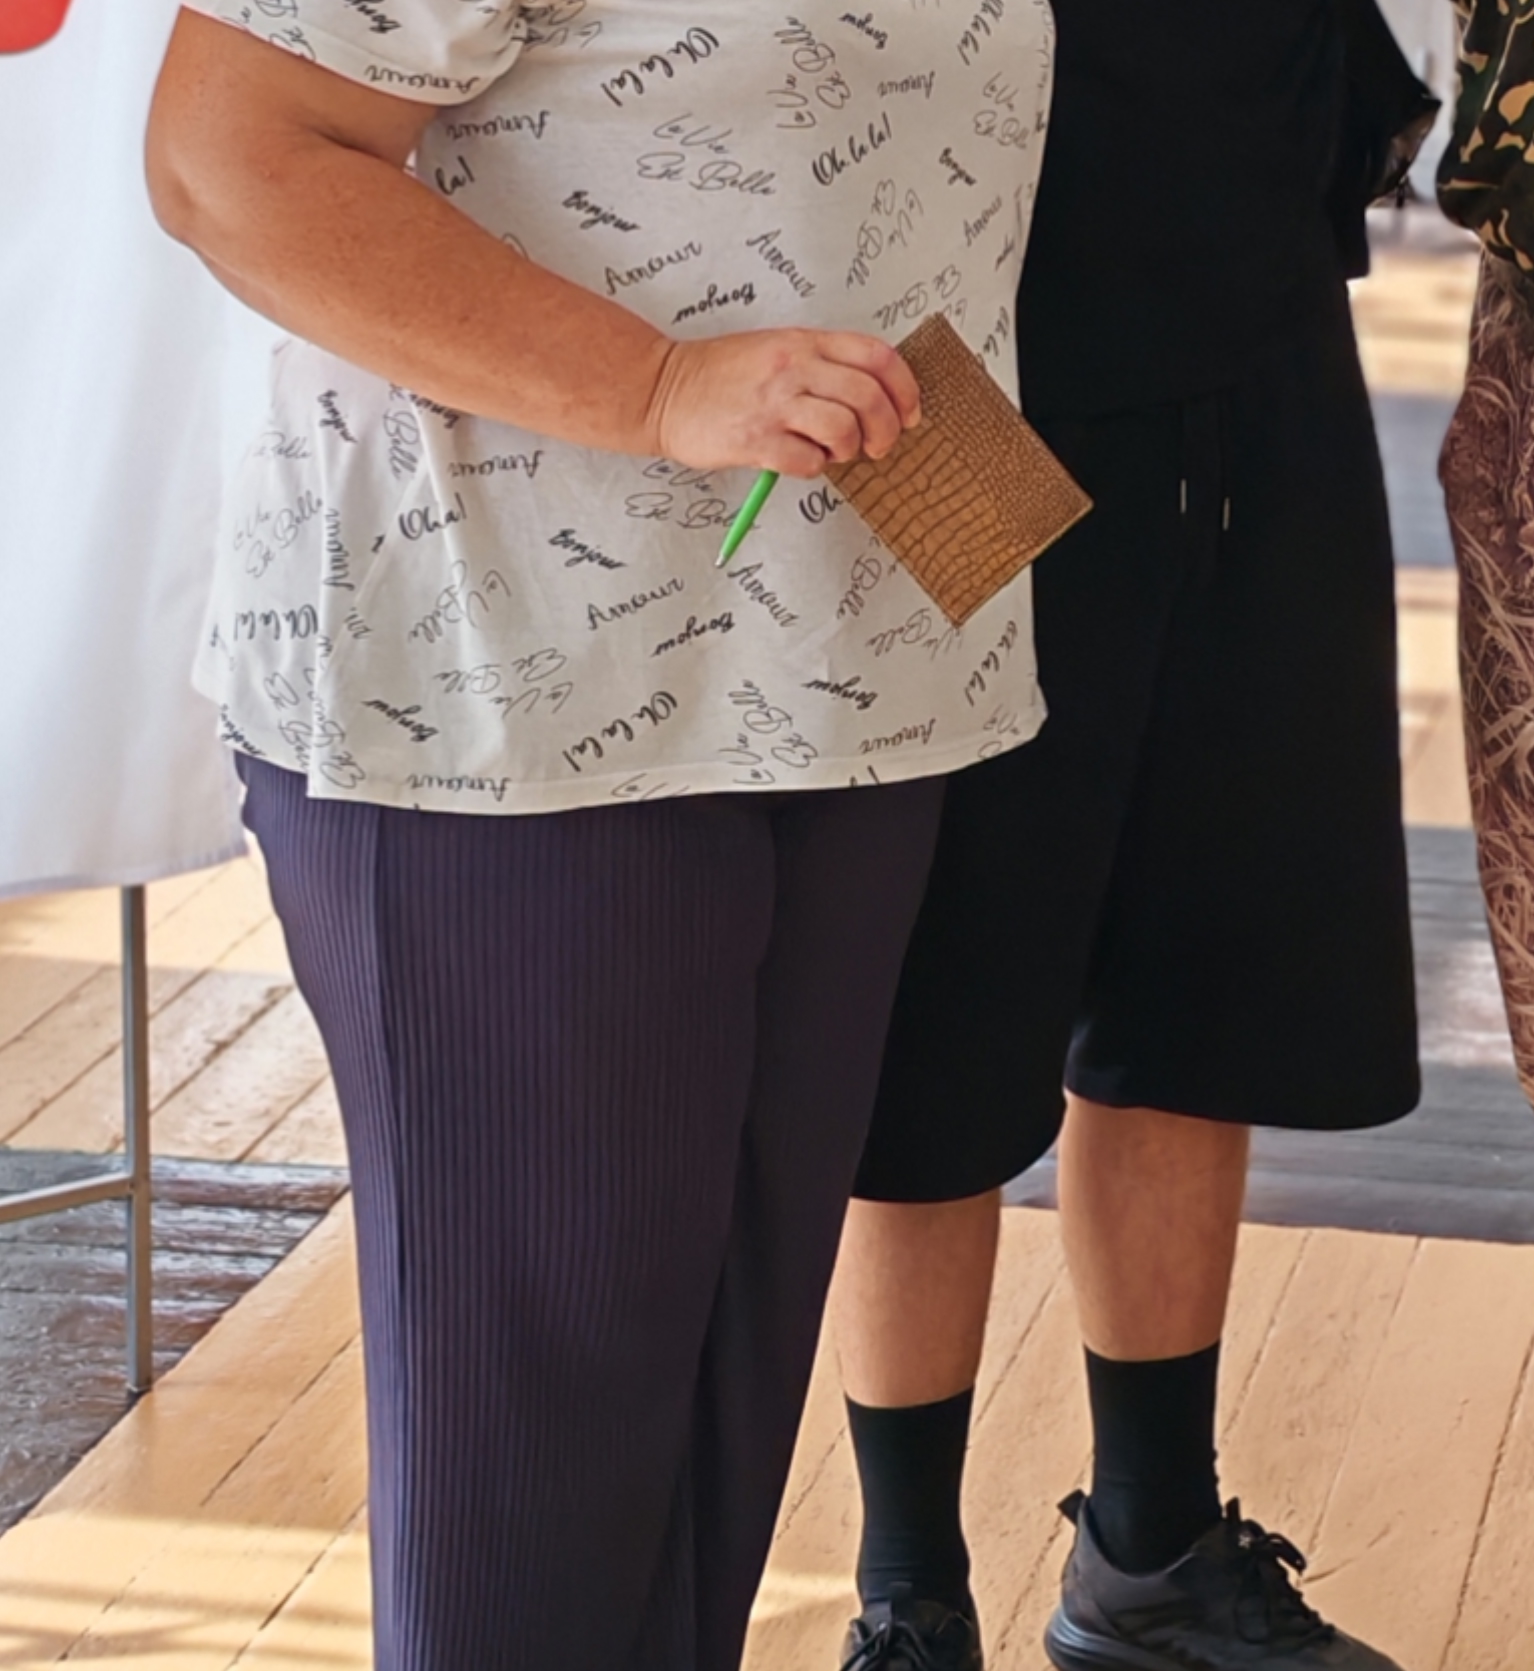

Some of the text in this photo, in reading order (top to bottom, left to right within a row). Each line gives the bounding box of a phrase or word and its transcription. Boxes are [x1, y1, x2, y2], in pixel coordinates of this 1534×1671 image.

[689, 160, 776, 196] Belle
[561, 190, 641, 230] Bonjour
[604, 240, 703, 295] Amour
[747, 229, 817, 298] Amour
[671, 283, 757, 325] Bonjour
[677, 498, 761, 529] Bele
[549, 529, 628, 568] Bonjour
[587, 578, 685, 630] Amour
[727, 563, 799, 628] Amour
[651, 612, 736, 658] Bonjour
[802, 676, 878, 710] Bonjour
[361, 699, 439, 742] Bonjour
